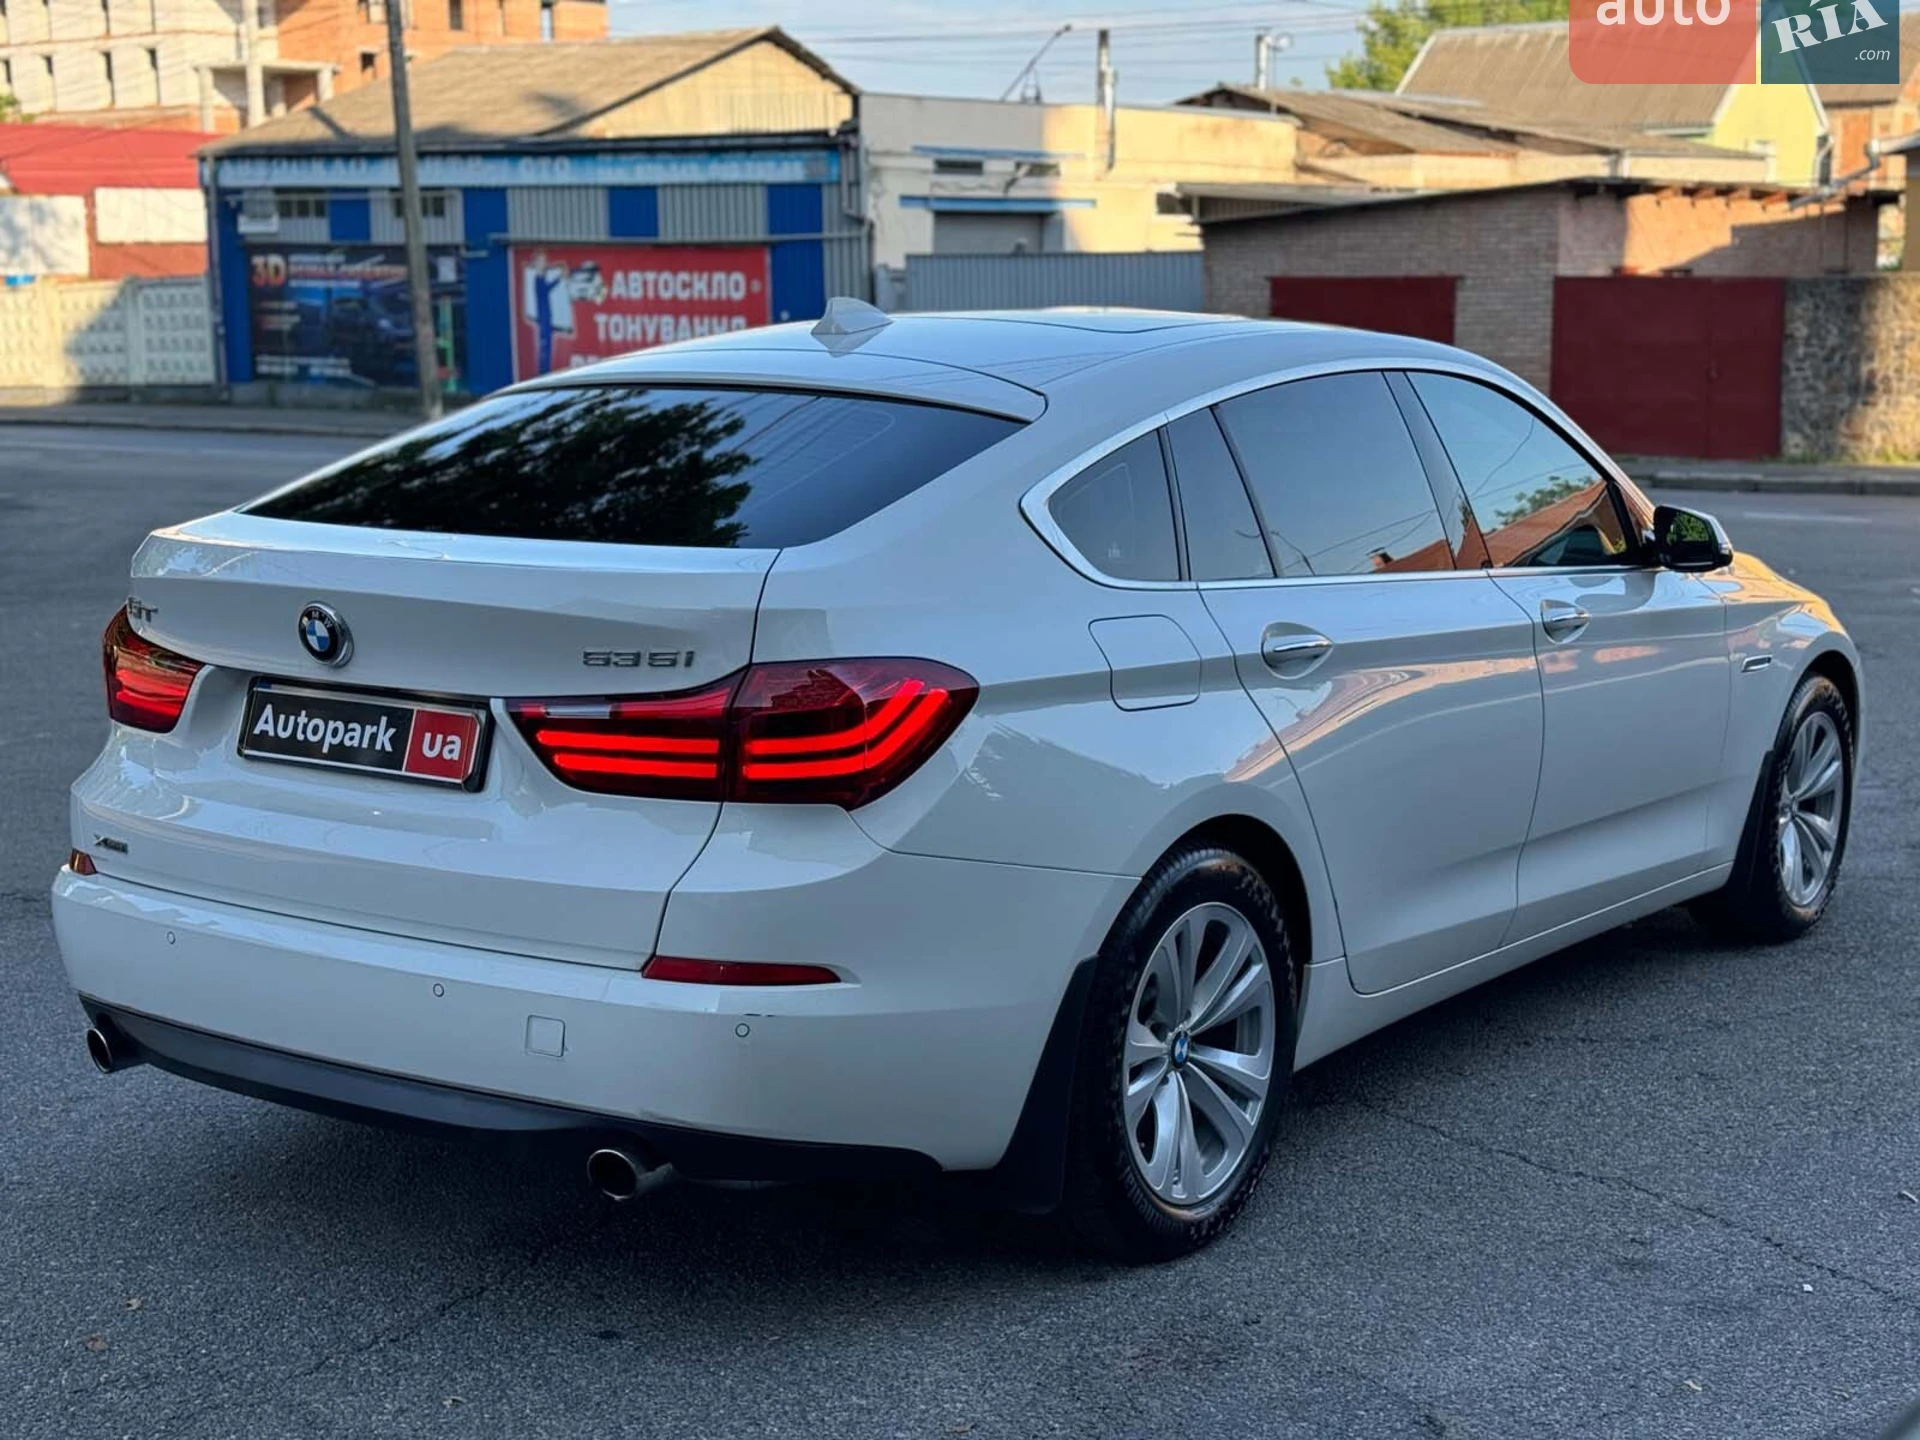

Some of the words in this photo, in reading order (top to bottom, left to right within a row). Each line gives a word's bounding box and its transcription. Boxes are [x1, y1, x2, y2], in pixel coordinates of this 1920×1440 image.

[250, 254, 286, 287] 3D
[610, 271, 746, 301] АВТОСКЛО
[583, 650, 696, 668] 535i
[253, 703, 397, 753] Autopark
[422, 731, 462, 761] ua
